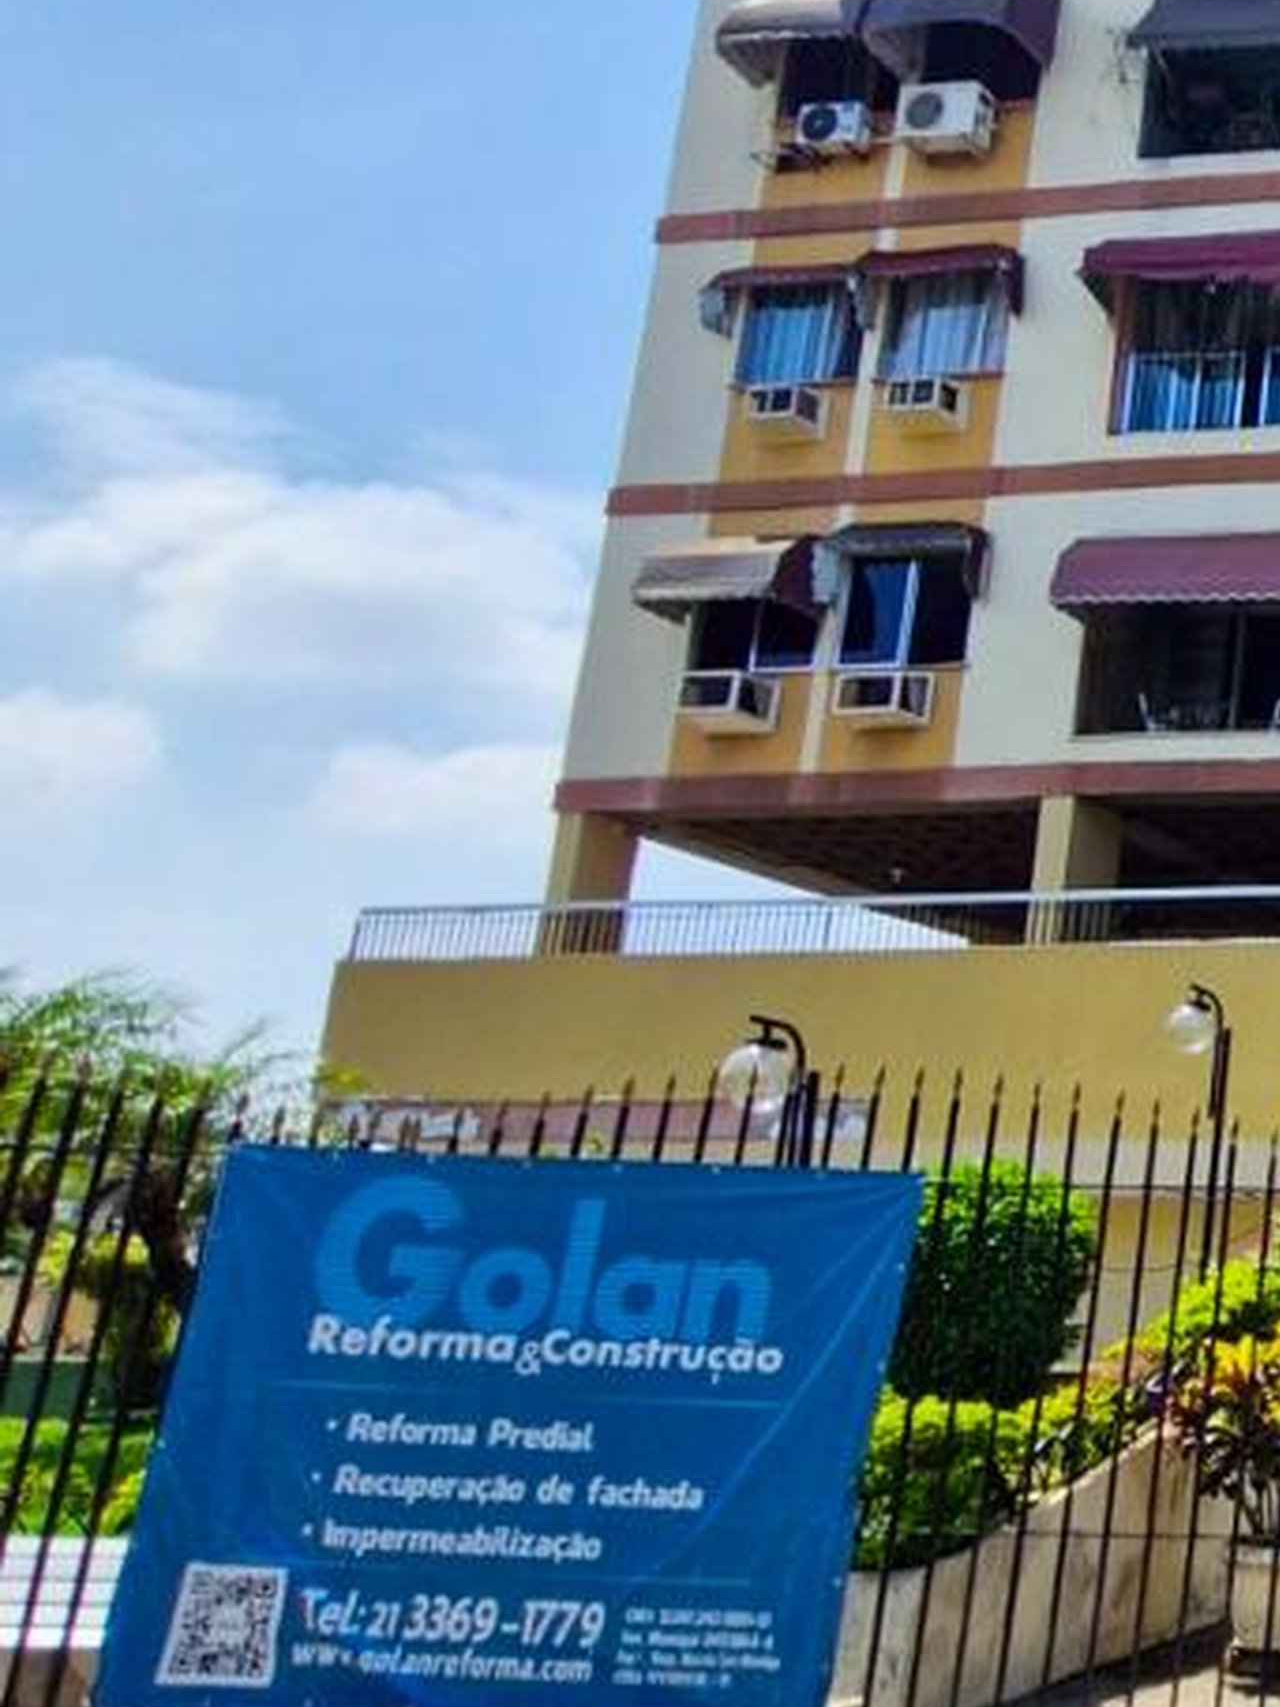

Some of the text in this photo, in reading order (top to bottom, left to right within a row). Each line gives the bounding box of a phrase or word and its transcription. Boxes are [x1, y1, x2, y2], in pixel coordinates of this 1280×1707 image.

[314, 1174, 772, 1346] Golan
[346, 1412, 594, 1452] Reforma Predial
[333, 1463, 705, 1511] Recuperação de fachada
[322, 1518, 602, 1564] Impermeabilização
[366, 1601, 401, 1638] 21
[291, 1641, 593, 1682] wwgolanreforma.com
